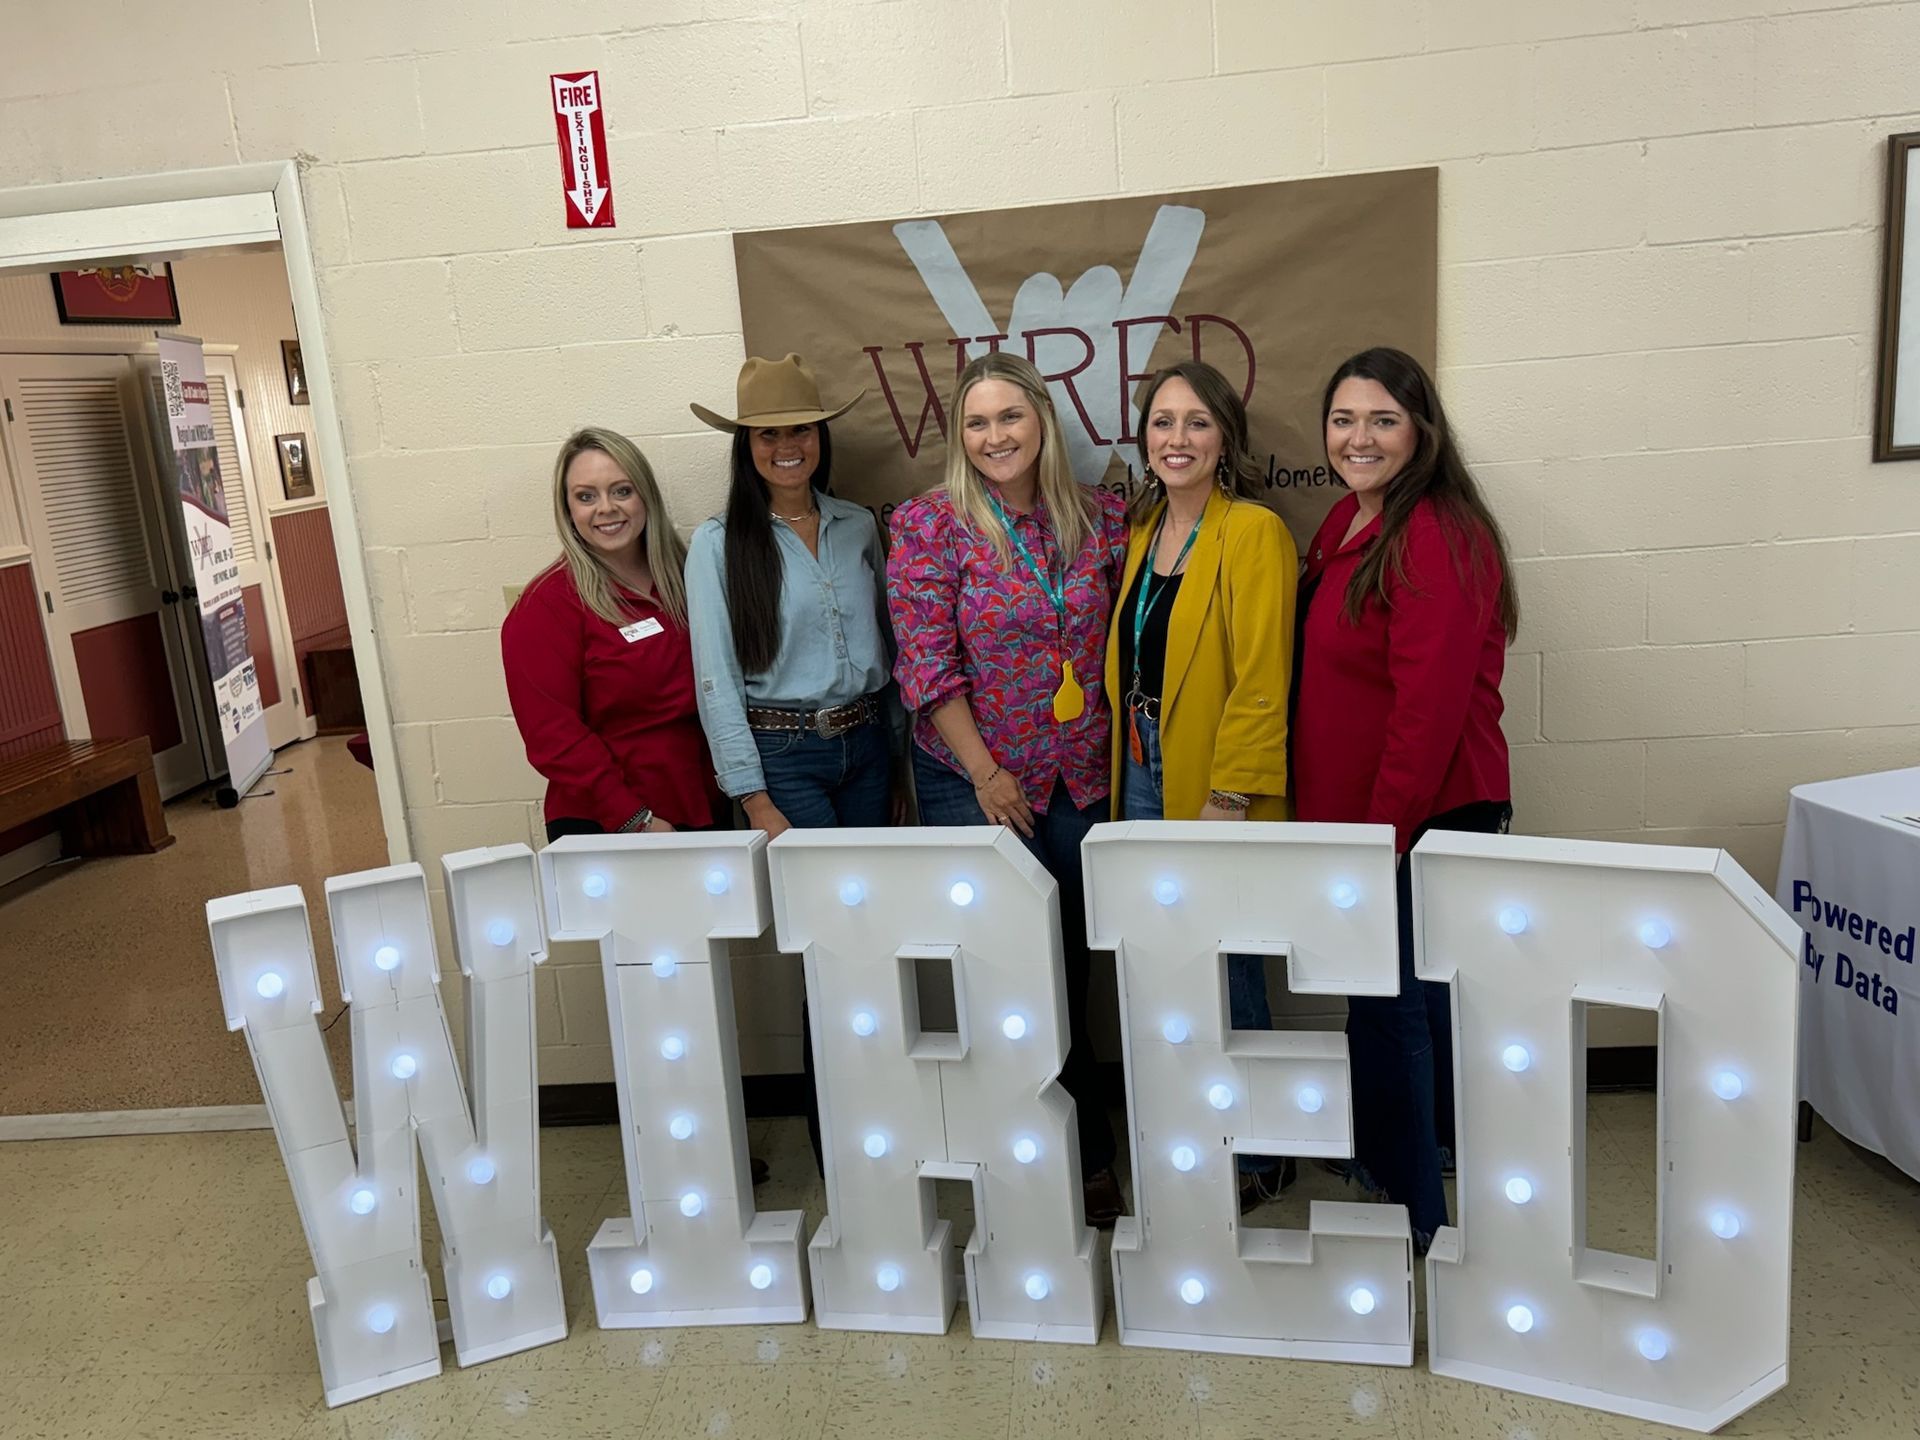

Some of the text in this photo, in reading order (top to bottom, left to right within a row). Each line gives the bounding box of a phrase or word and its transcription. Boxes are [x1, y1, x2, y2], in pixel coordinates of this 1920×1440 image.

[560, 85, 593, 108] FIRE
[574, 111, 594, 214] EXTINGUISHER
[863, 314, 1256, 459] WRED
[1793, 880, 1916, 965] Powered
[1805, 932, 1899, 1016] by Data
[206, 820, 1803, 1434] WIRED
